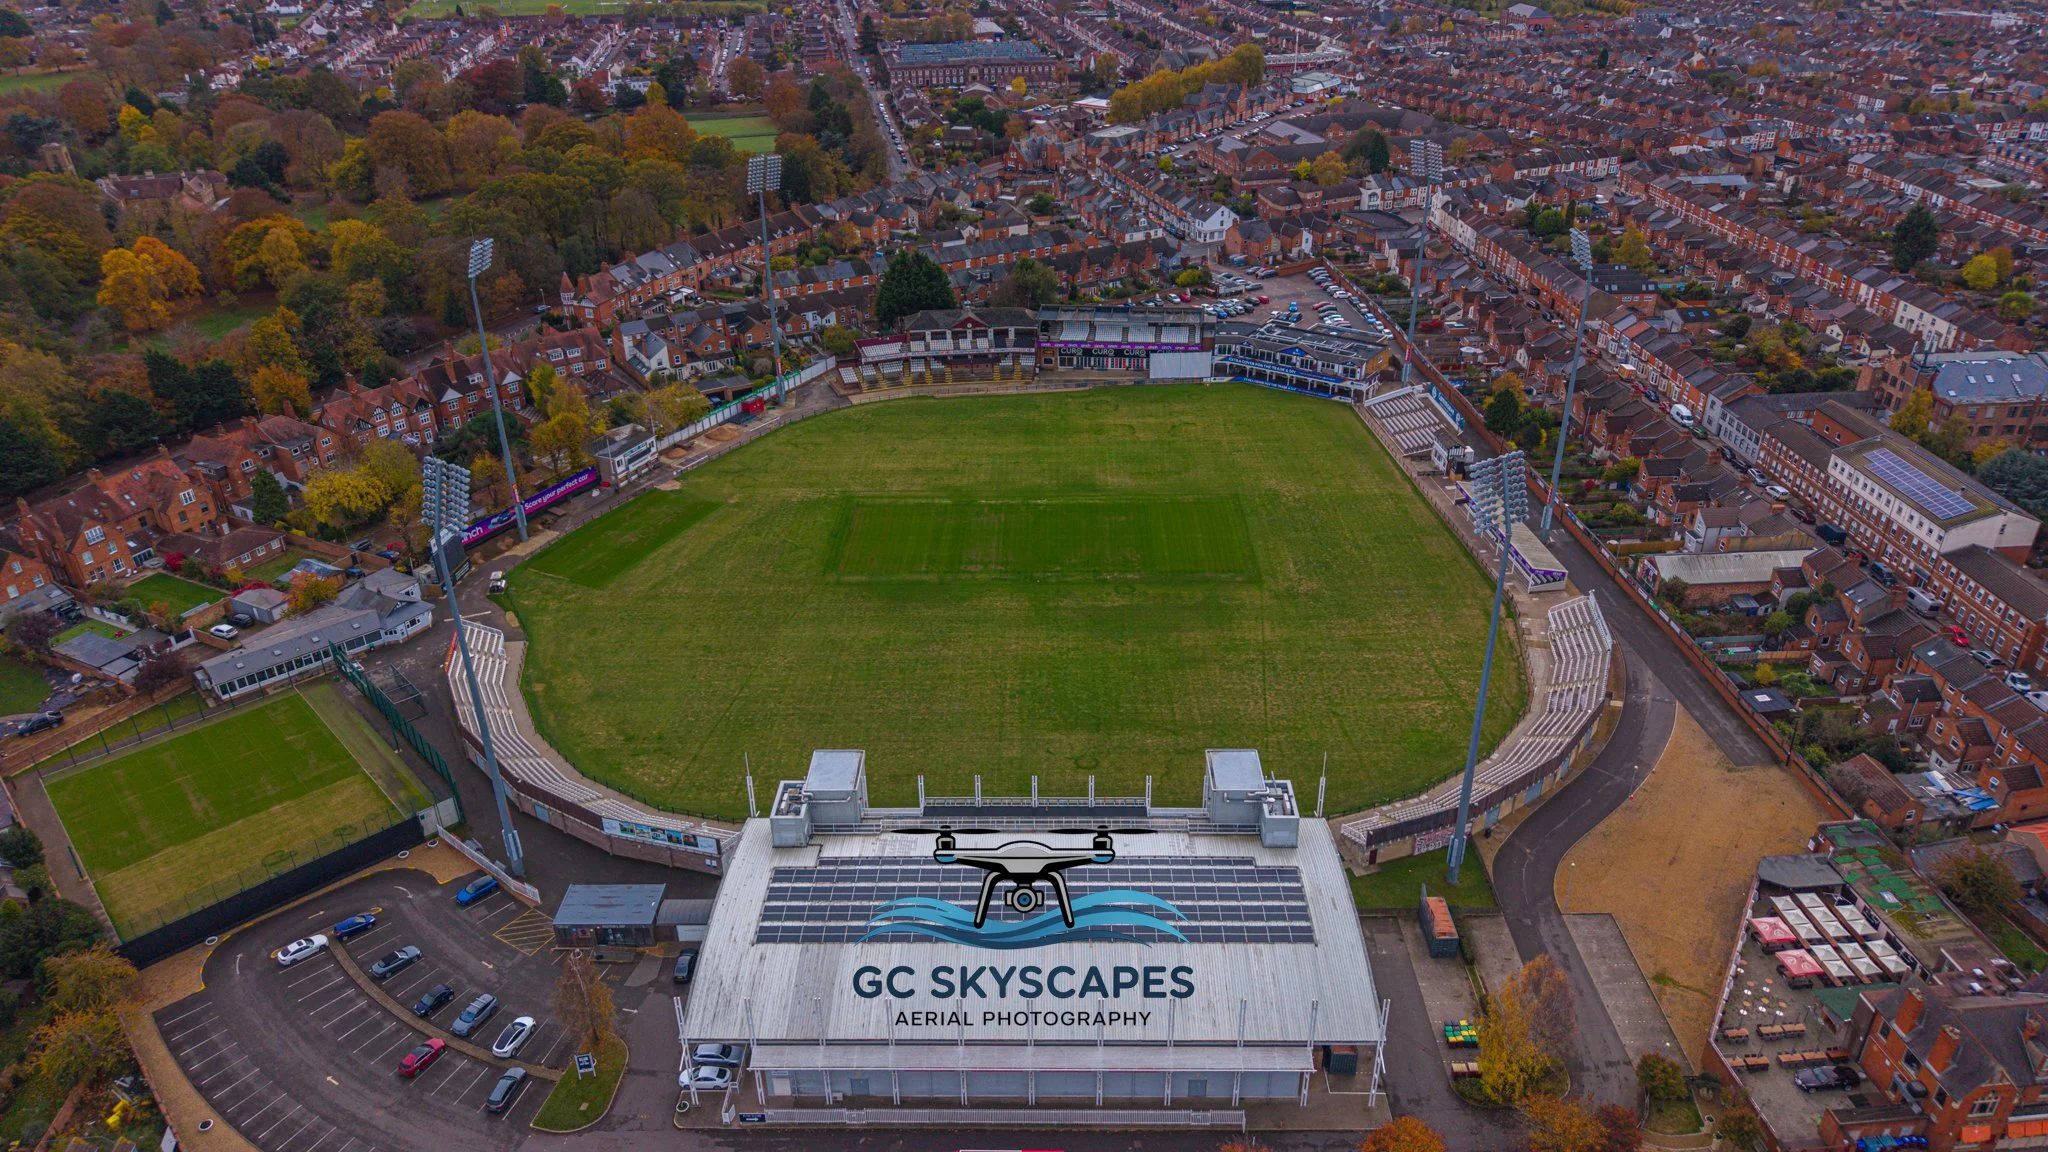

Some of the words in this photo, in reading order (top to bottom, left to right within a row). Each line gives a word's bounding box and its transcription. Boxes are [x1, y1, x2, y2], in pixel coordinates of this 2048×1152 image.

[524, 498, 543, 510] Score
[542, 490, 556, 503] your
[556, 479, 578, 496] perfect
[578, 474, 589, 483] car
